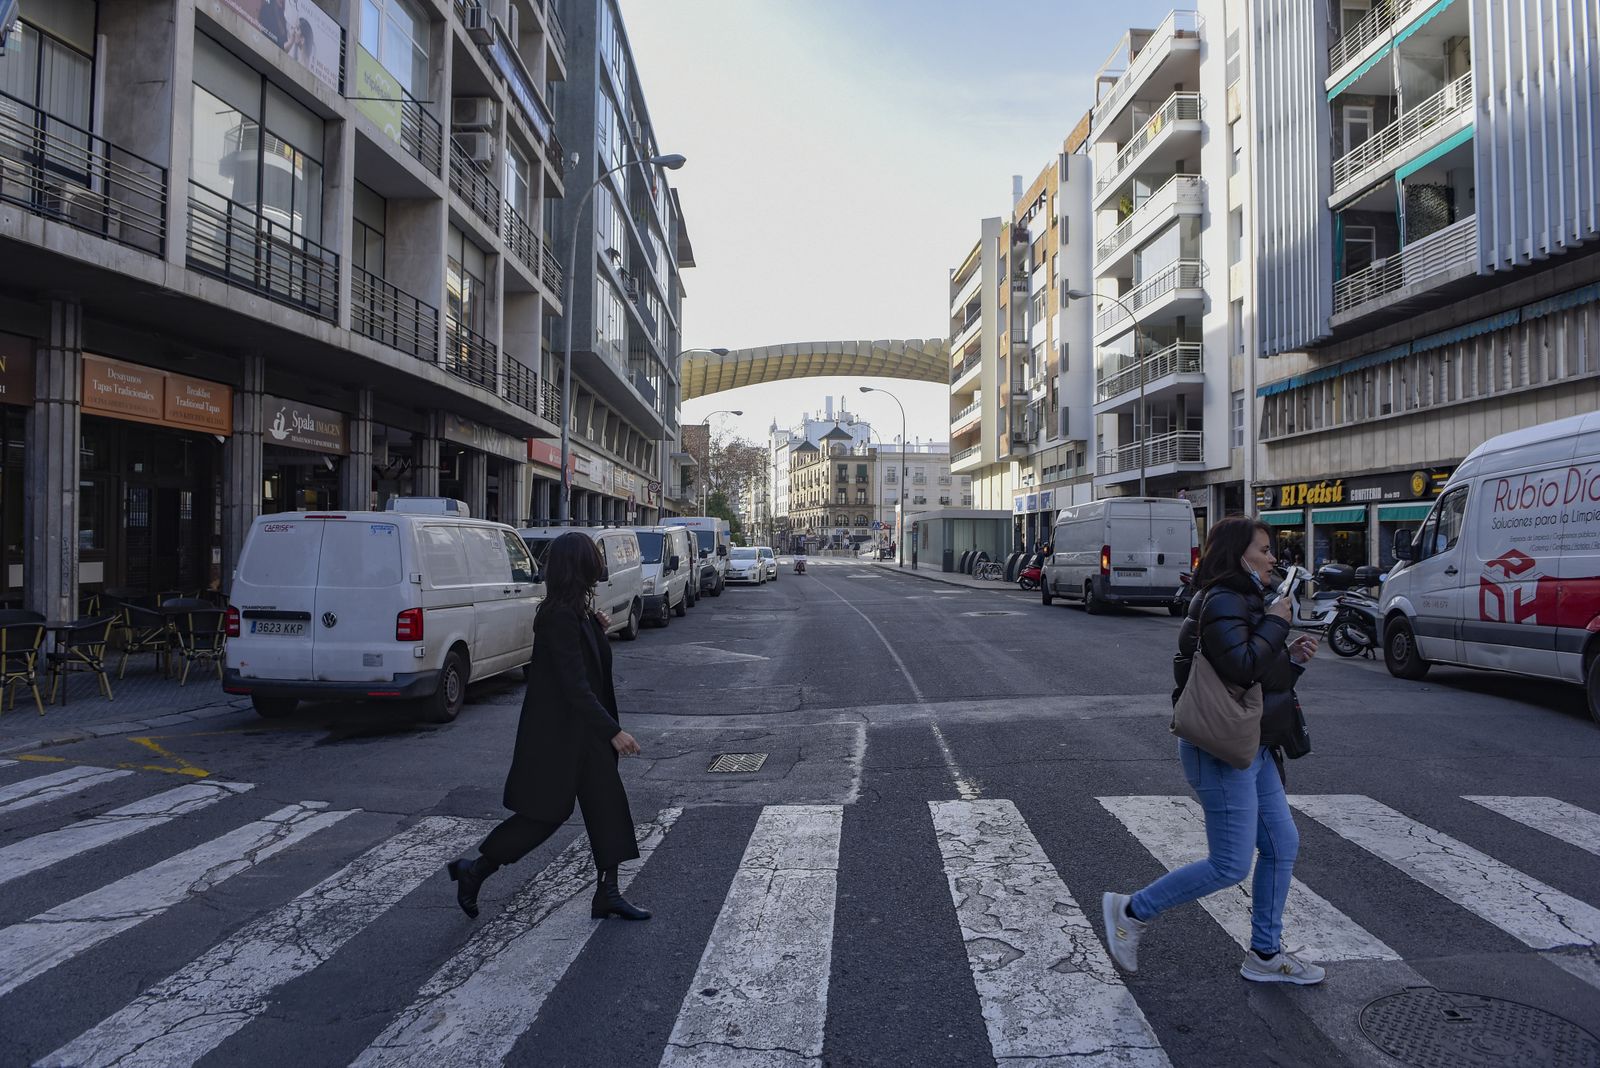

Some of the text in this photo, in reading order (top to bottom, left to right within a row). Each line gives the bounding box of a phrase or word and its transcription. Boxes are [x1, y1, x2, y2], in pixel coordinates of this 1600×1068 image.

[107, 367, 142, 385] Desayunos
[92, 379, 154, 401] Tapas Tradicionales
[186, 385, 211, 399] Breakfast
[175, 396, 205, 411] Traditional
[205, 402, 220, 414] Tapas
[292, 410, 341, 436] Spala IMAGEN
[1281, 484, 1296, 506] El
[1297, 480, 1343, 505] Petisú
[1494, 474, 1559, 512] Rubio
[1492, 517, 1533, 530] Soluciones
[1534, 515, 1557, 528] para
[1560, 510, 1569, 524] la
[257, 622, 303, 634] 3623 KKP
